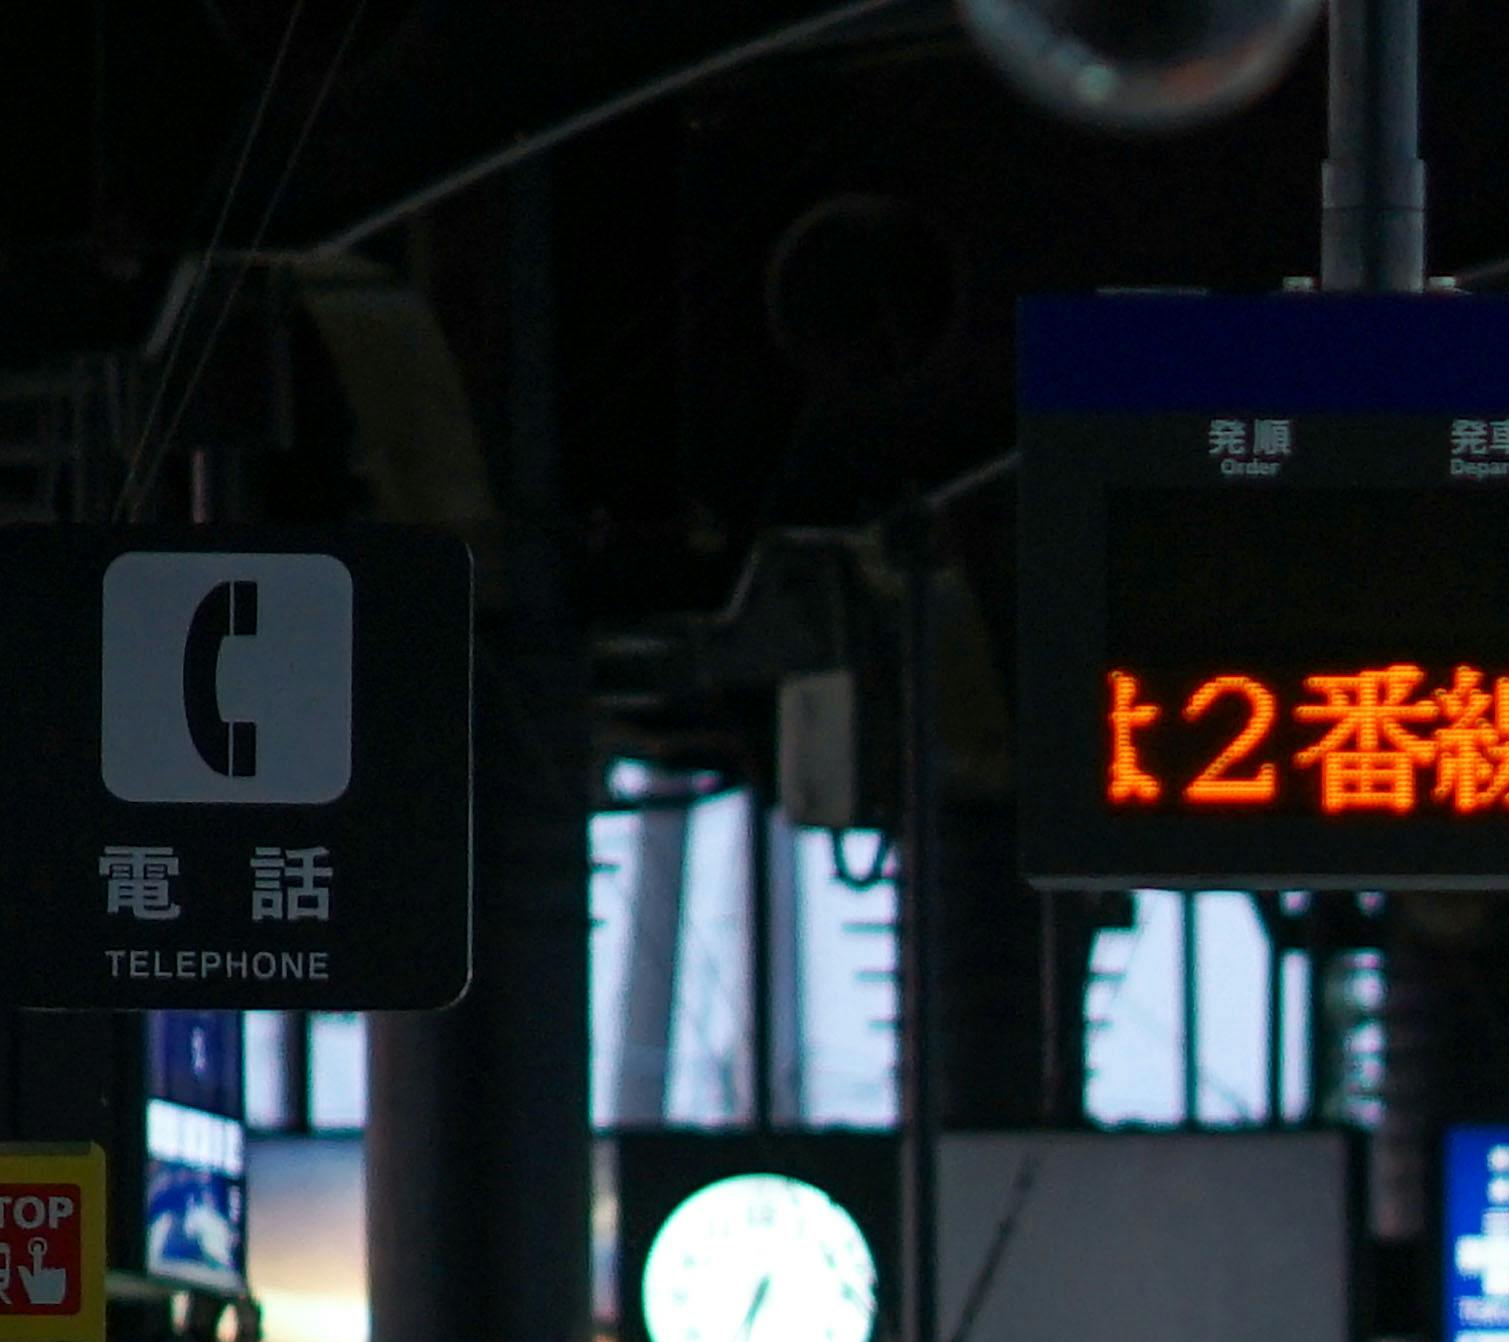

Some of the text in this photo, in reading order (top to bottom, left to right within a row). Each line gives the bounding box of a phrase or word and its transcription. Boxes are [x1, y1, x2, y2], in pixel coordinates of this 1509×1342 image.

[1207, 418, 1291, 456] 発順
[1221, 459, 1280, 475] Order
[98, 845, 334, 921] 電話
[105, 949, 330, 980] TELEPHONE
